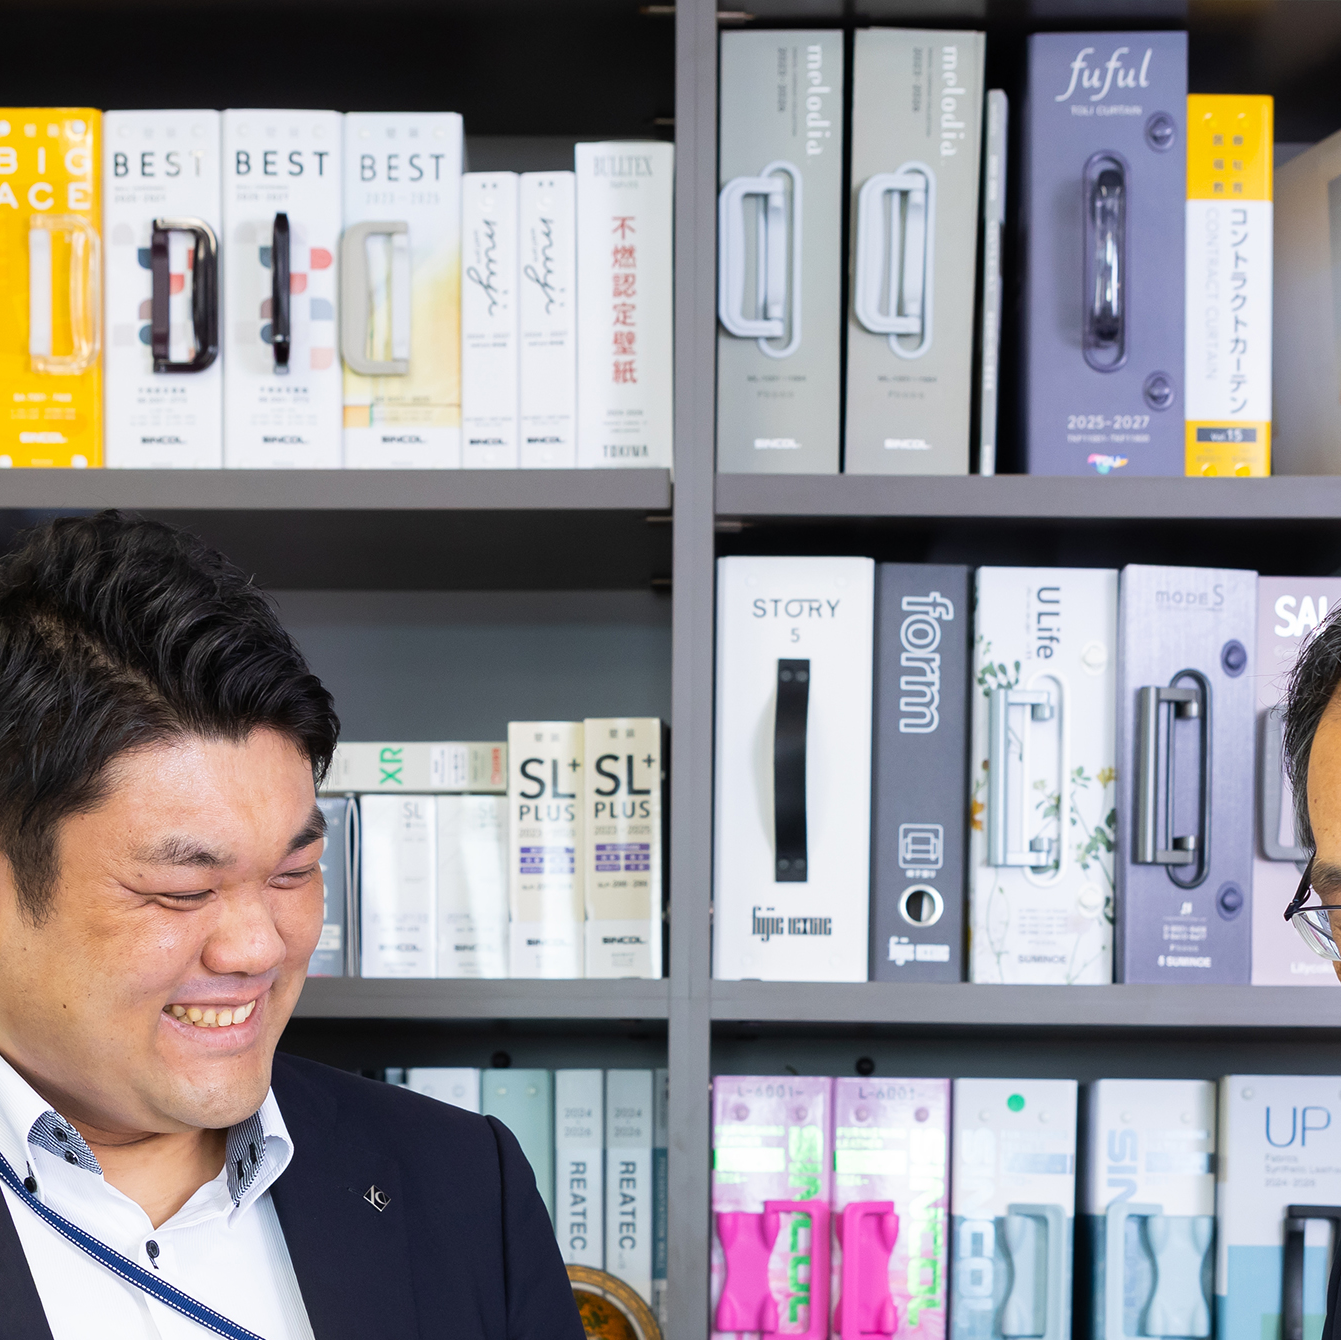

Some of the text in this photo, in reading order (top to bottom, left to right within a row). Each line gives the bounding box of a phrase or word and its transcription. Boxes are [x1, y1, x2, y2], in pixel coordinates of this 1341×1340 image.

[1055, 47, 1154, 102] fuful
[805, 44, 832, 157] melodia
[939, 46, 966, 158] melodia
[113, 151, 205, 178] BEST
[235, 150, 330, 176] BEST
[360, 153, 446, 182] BEST
[611, 215, 638, 385] 不燃認定壁紙
[1228, 208, 1249, 415] コントラクトカーテン
[1067, 414, 1151, 429] 2025-2027
[752, 598, 841, 618] STORY
[789, 628, 801, 643] 5
[1035, 611, 1061, 660] Life
[898, 590, 955, 734] form
[379, 747, 403, 786] XR
[518, 804, 576, 822] PLUS
[594, 800, 651, 820] PLUS
[1264, 1105, 1332, 1148] UP
[569, 1161, 587, 1252] REATEC
[618, 1160, 637, 1250] REATEC
